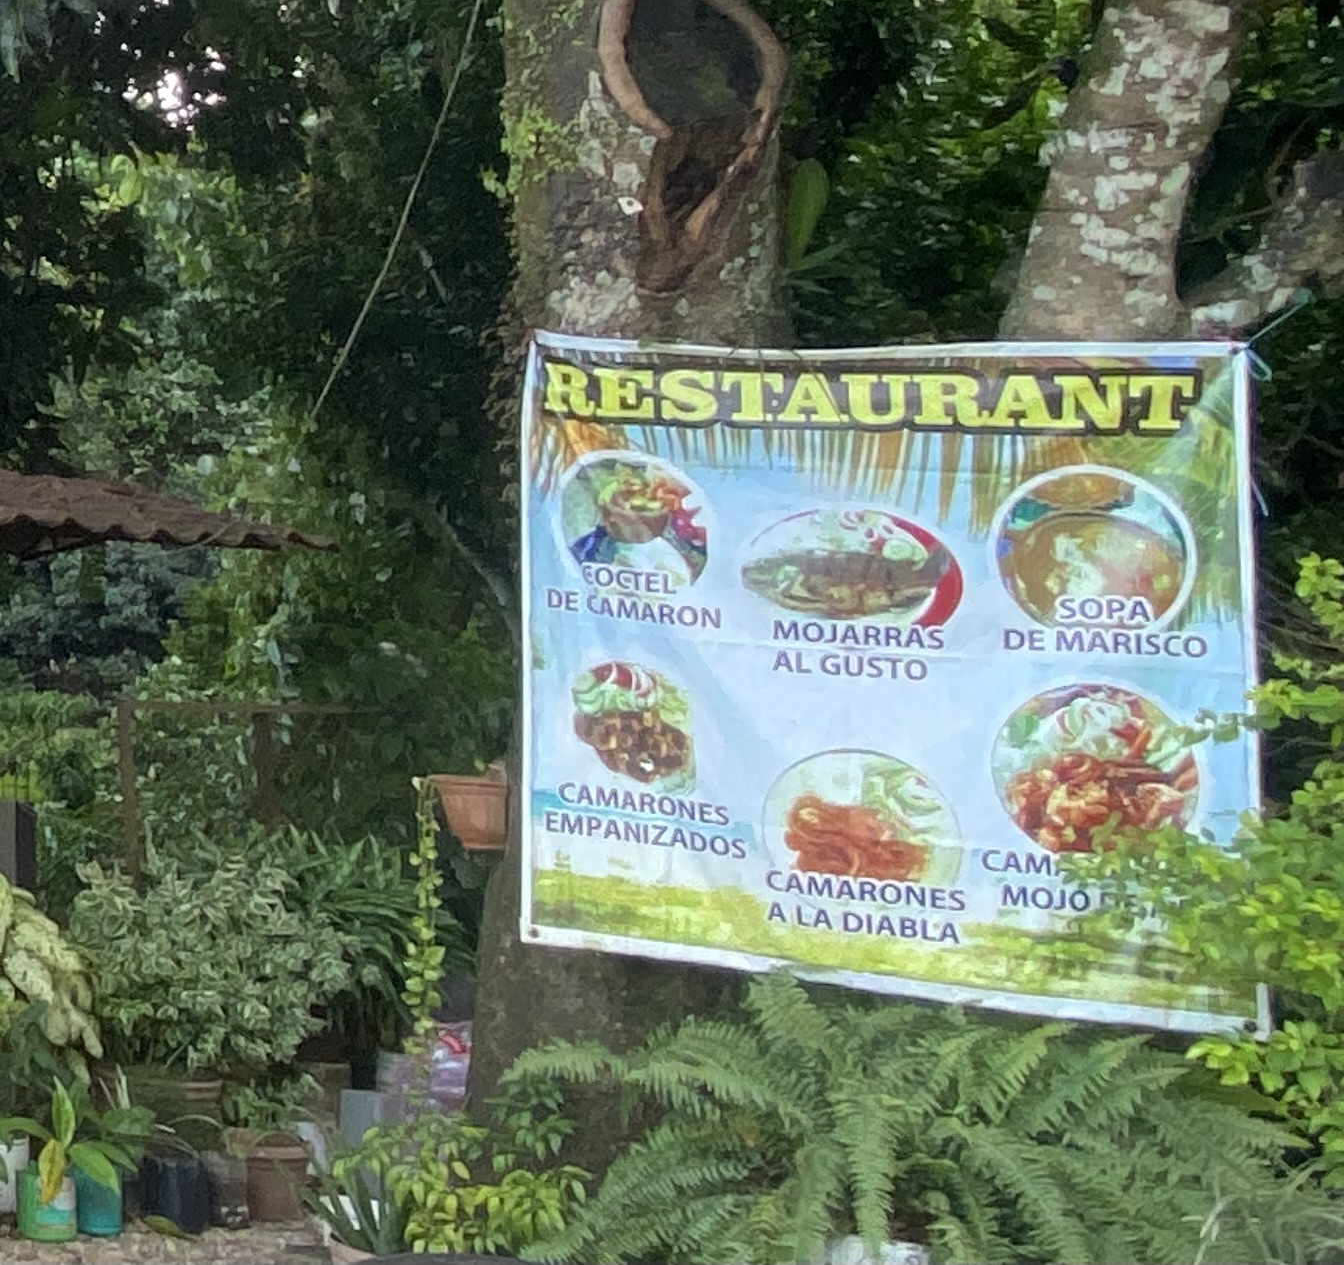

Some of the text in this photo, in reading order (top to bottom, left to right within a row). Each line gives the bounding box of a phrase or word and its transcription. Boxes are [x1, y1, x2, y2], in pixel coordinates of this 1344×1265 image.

[543, 361, 1196, 431] RESTAURANT
[581, 565, 677, 595] COCTEL
[546, 589, 722, 629] DE CAMARON
[1058, 596, 1151, 622] SOPA
[772, 619, 945, 650] MOJARRAS
[1002, 628, 1208, 659] DE MARISCO
[772, 650, 928, 681] AL GUSTO
[558, 781, 730, 827] CAMARONES
[545, 811, 747, 860] EMPANIZADOS
[765, 869, 967, 912] CAMARONES
[1001, 883, 1091, 912] MOJO
[767, 901, 961, 945] A LA DIABLA
